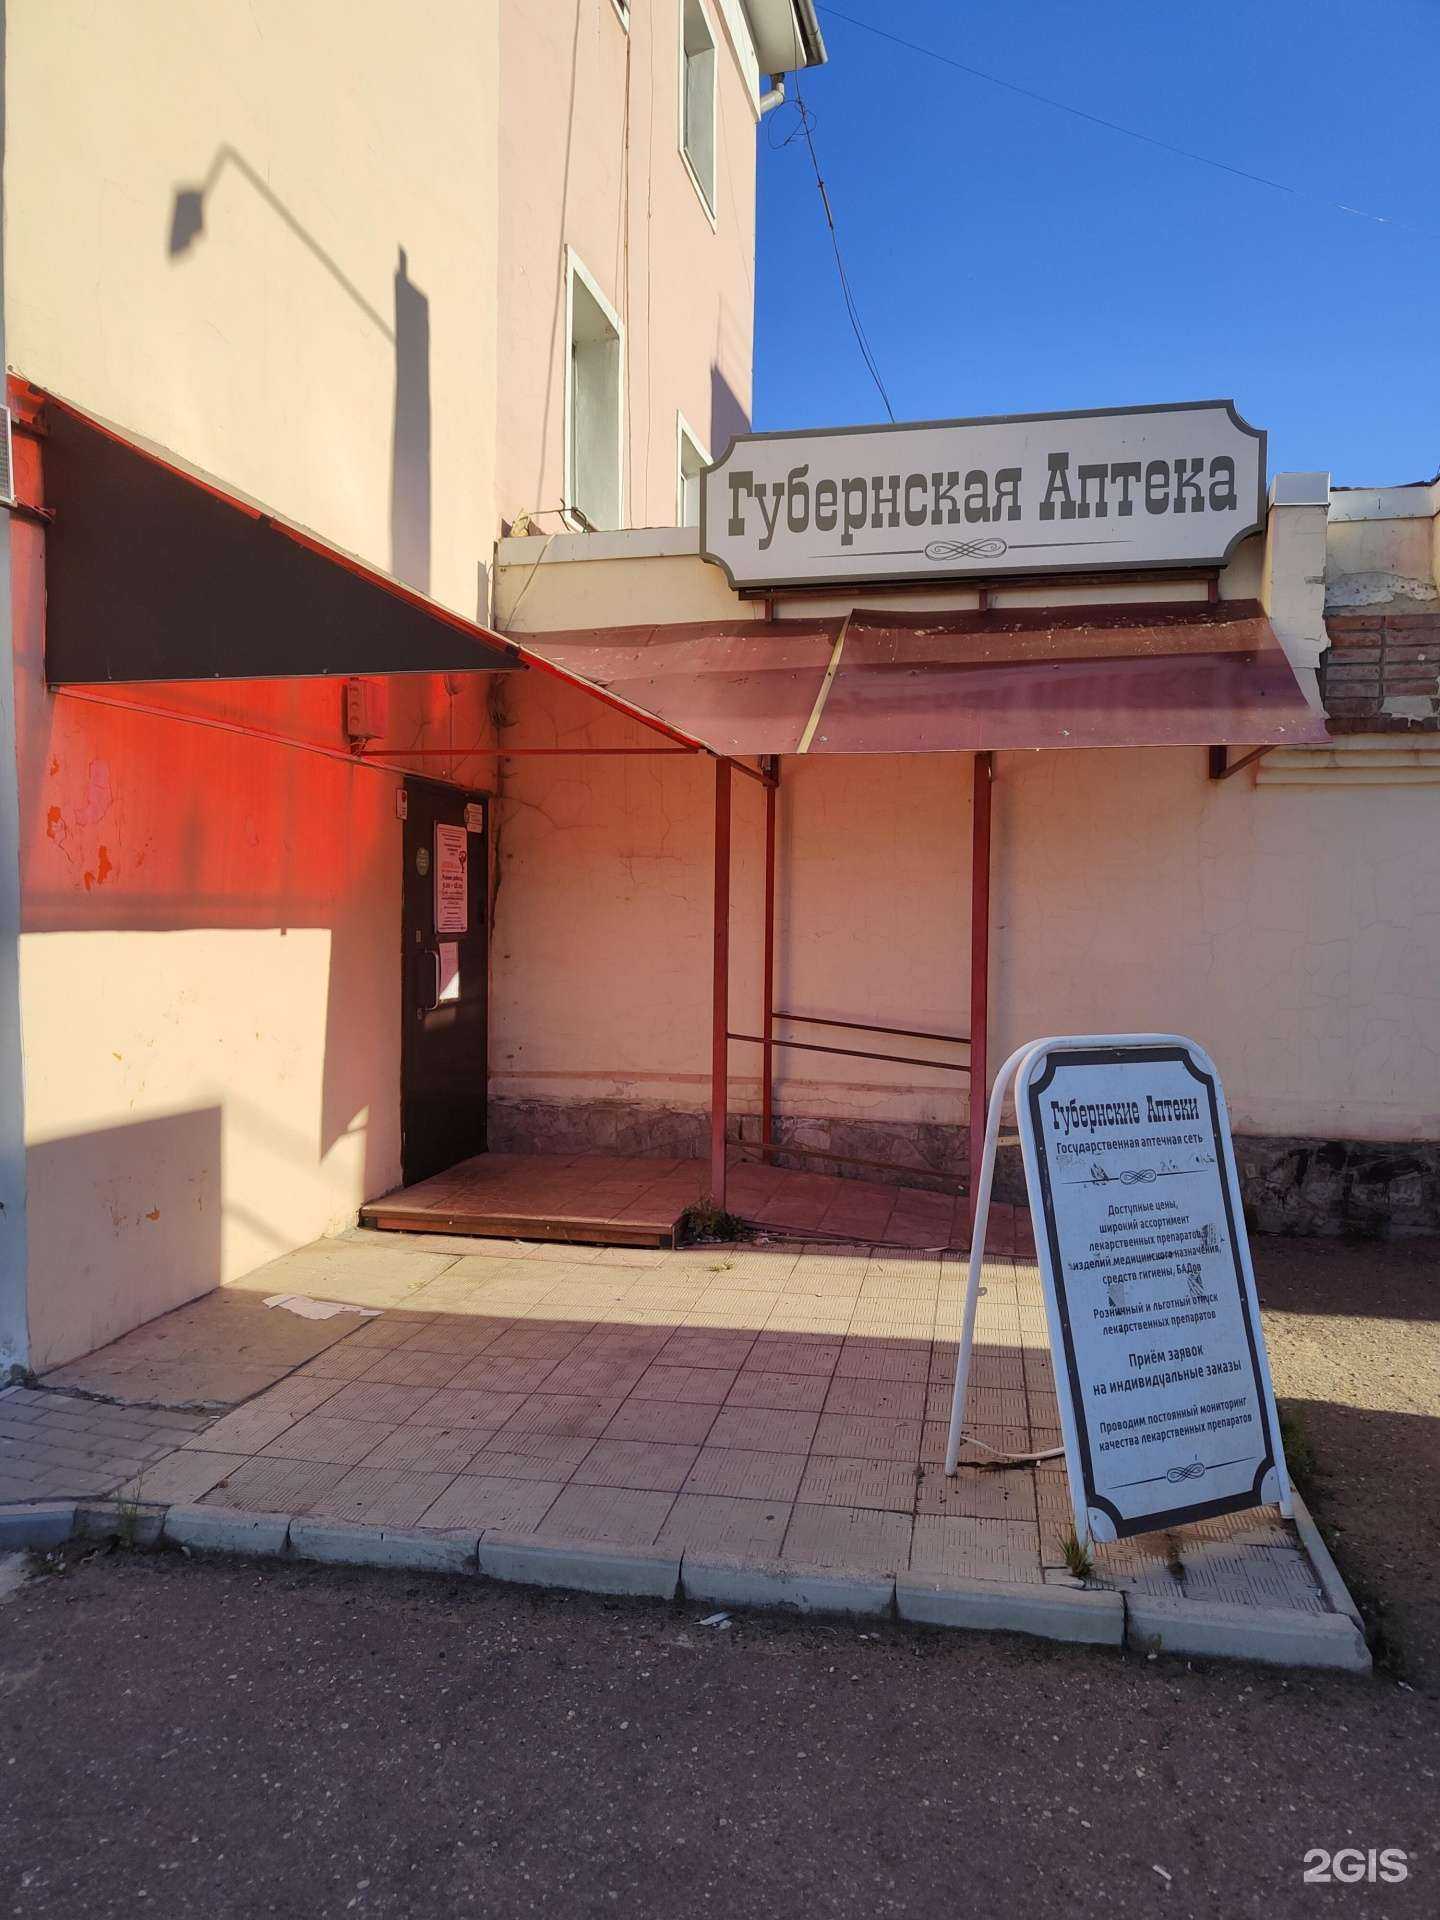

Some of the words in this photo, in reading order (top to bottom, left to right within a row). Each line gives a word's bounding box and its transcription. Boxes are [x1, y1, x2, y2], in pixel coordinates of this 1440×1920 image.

[727, 463, 1022, 550] Губернская
[1039, 452, 1237, 521] Аптека
[1050, 1098, 1140, 1135] Губернские
[1146, 1095, 1200, 1123] Аптеки
[1056, 1137, 1140, 1156] Государственная
[1141, 1135, 1182, 1149] аптечная
[1183, 1133, 1203, 1144] сеть
[1108, 1202, 1154, 1217] Доступные
[1155, 1199, 1178, 1211] цены,
[1099, 1219, 1139, 1234] широкий
[1140, 1215, 1190, 1231] ассортимент
[1073, 1256, 1112, 1271] изделий
[1113, 1251, 1173, 1266] медицинского
[1174, 1243, 1222, 1258] назначения,
[1089, 1237, 1155, 1251] лекарственных
[1102, 1271, 1137, 1286] средств
[1139, 1266, 1176, 1280] гигиены,
[1176, 1263, 1202, 1277] БАДов
[1093, 1302, 1144, 1319] Розничный
[1146, 1304, 1151, 1312] и
[1153, 1295, 1191, 1310] льготный
[1192, 1293, 1219, 1306] отпуск
[1102, 1319, 1170, 1336] лекарственных
[1171, 1310, 1217, 1328] препаратов
[1128, 1350, 1166, 1370] Приём
[1168, 1343, 1204, 1361] заявок
[1093, 1383, 1107, 1396] на
[1109, 1367, 1204, 1393] индивидуальные
[1206, 1360, 1242, 1376] заказы
[1100, 1417, 1146, 1435] Проводим
[1148, 1405, 1199, 1426] постоянный
[1200, 1397, 1247, 1414] мониторинг
[1099, 1435, 1140, 1452] качества
[1141, 1423, 1207, 1445] лекарственных
[1207, 1413, 1253, 1433] препаратов
